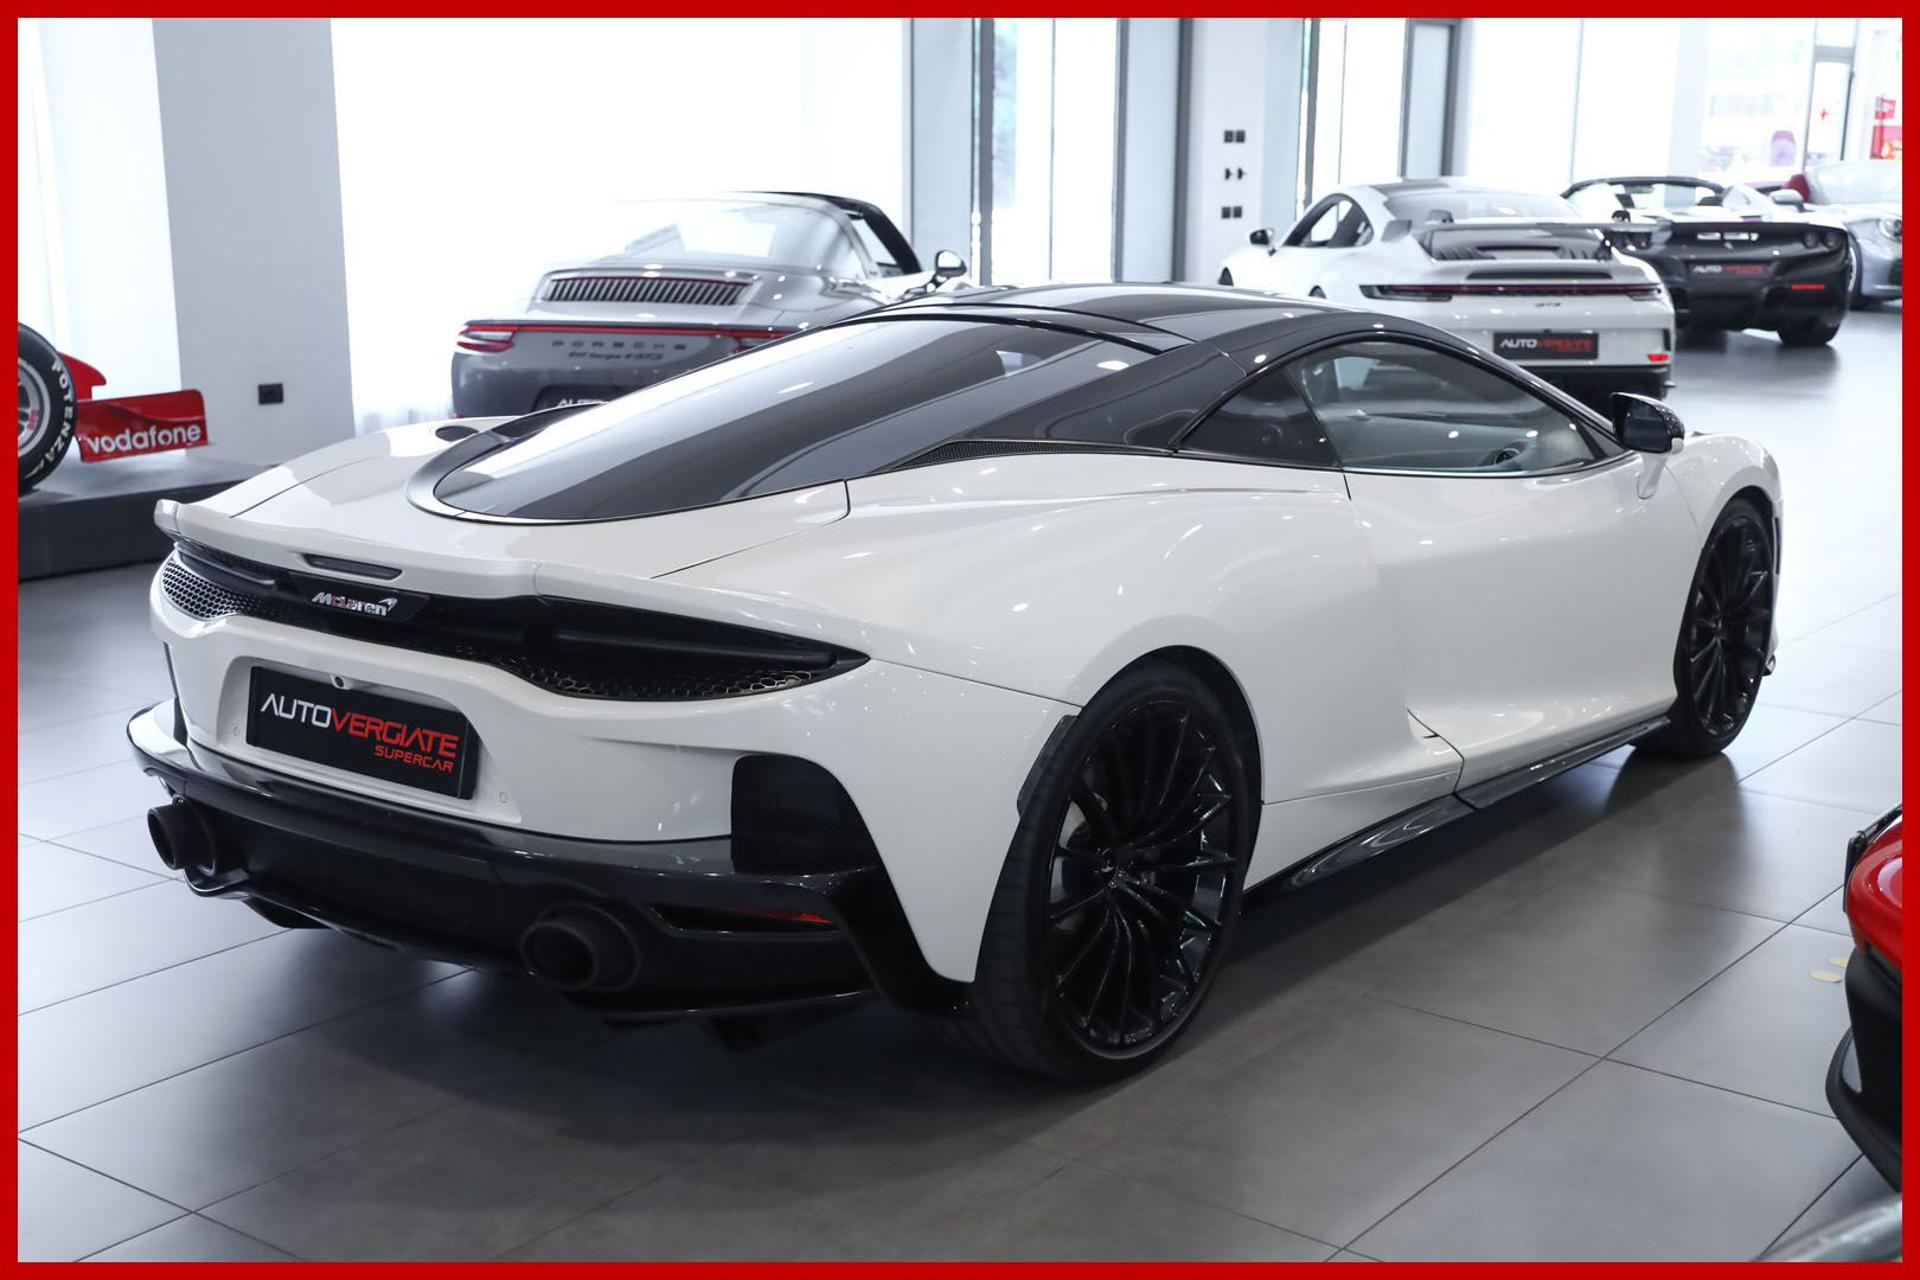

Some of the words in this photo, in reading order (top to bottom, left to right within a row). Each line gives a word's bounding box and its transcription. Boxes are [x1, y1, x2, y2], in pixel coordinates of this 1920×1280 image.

[45, 359, 75, 462] POTENZA
[85, 423, 201, 454] vodafone
[311, 591, 387, 617] McLaren
[260, 692, 460, 759] AUTOVERGIATE
[374, 744, 454, 774] SUPERCAR
